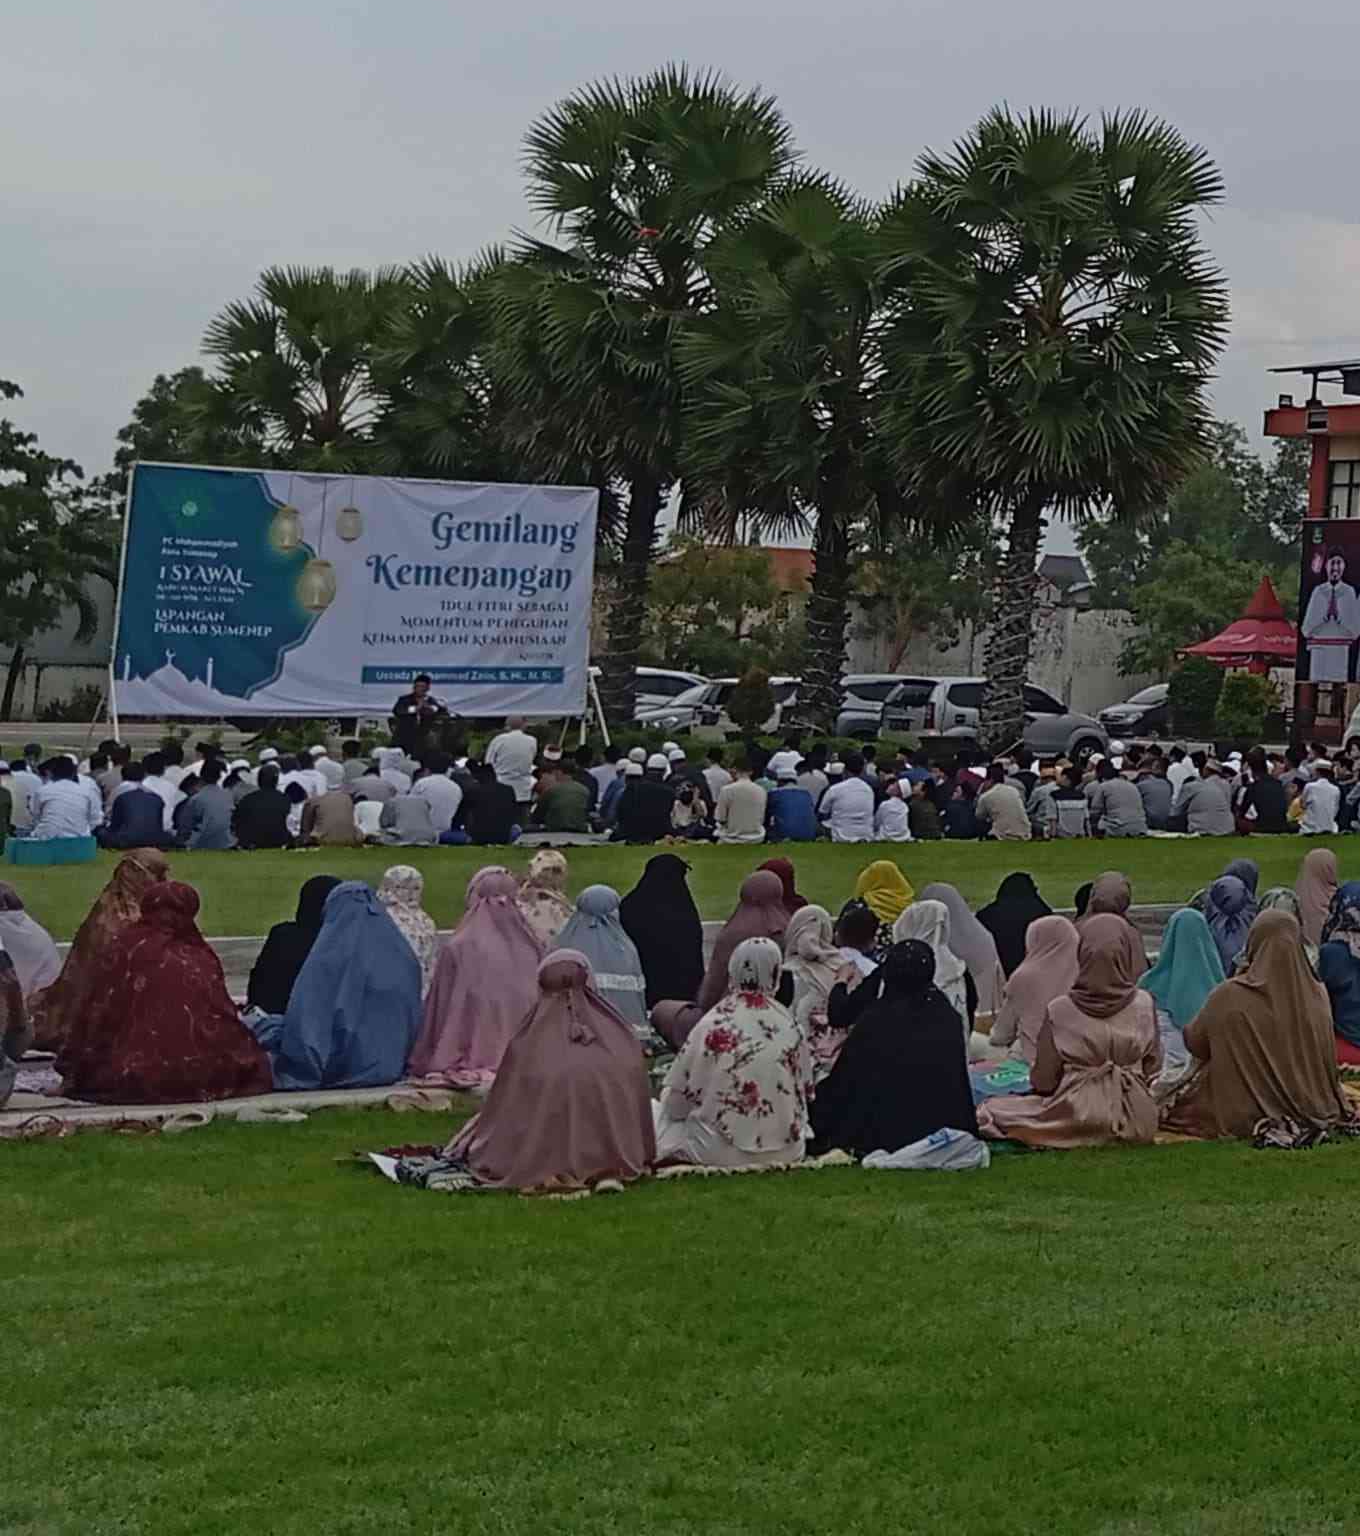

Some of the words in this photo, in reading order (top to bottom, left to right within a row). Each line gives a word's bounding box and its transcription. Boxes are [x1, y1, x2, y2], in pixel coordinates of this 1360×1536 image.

[432, 511, 579, 554] Gemilang
[171, 564, 253, 587] SYAWAL
[366, 554, 573, 597] Kemenangan
